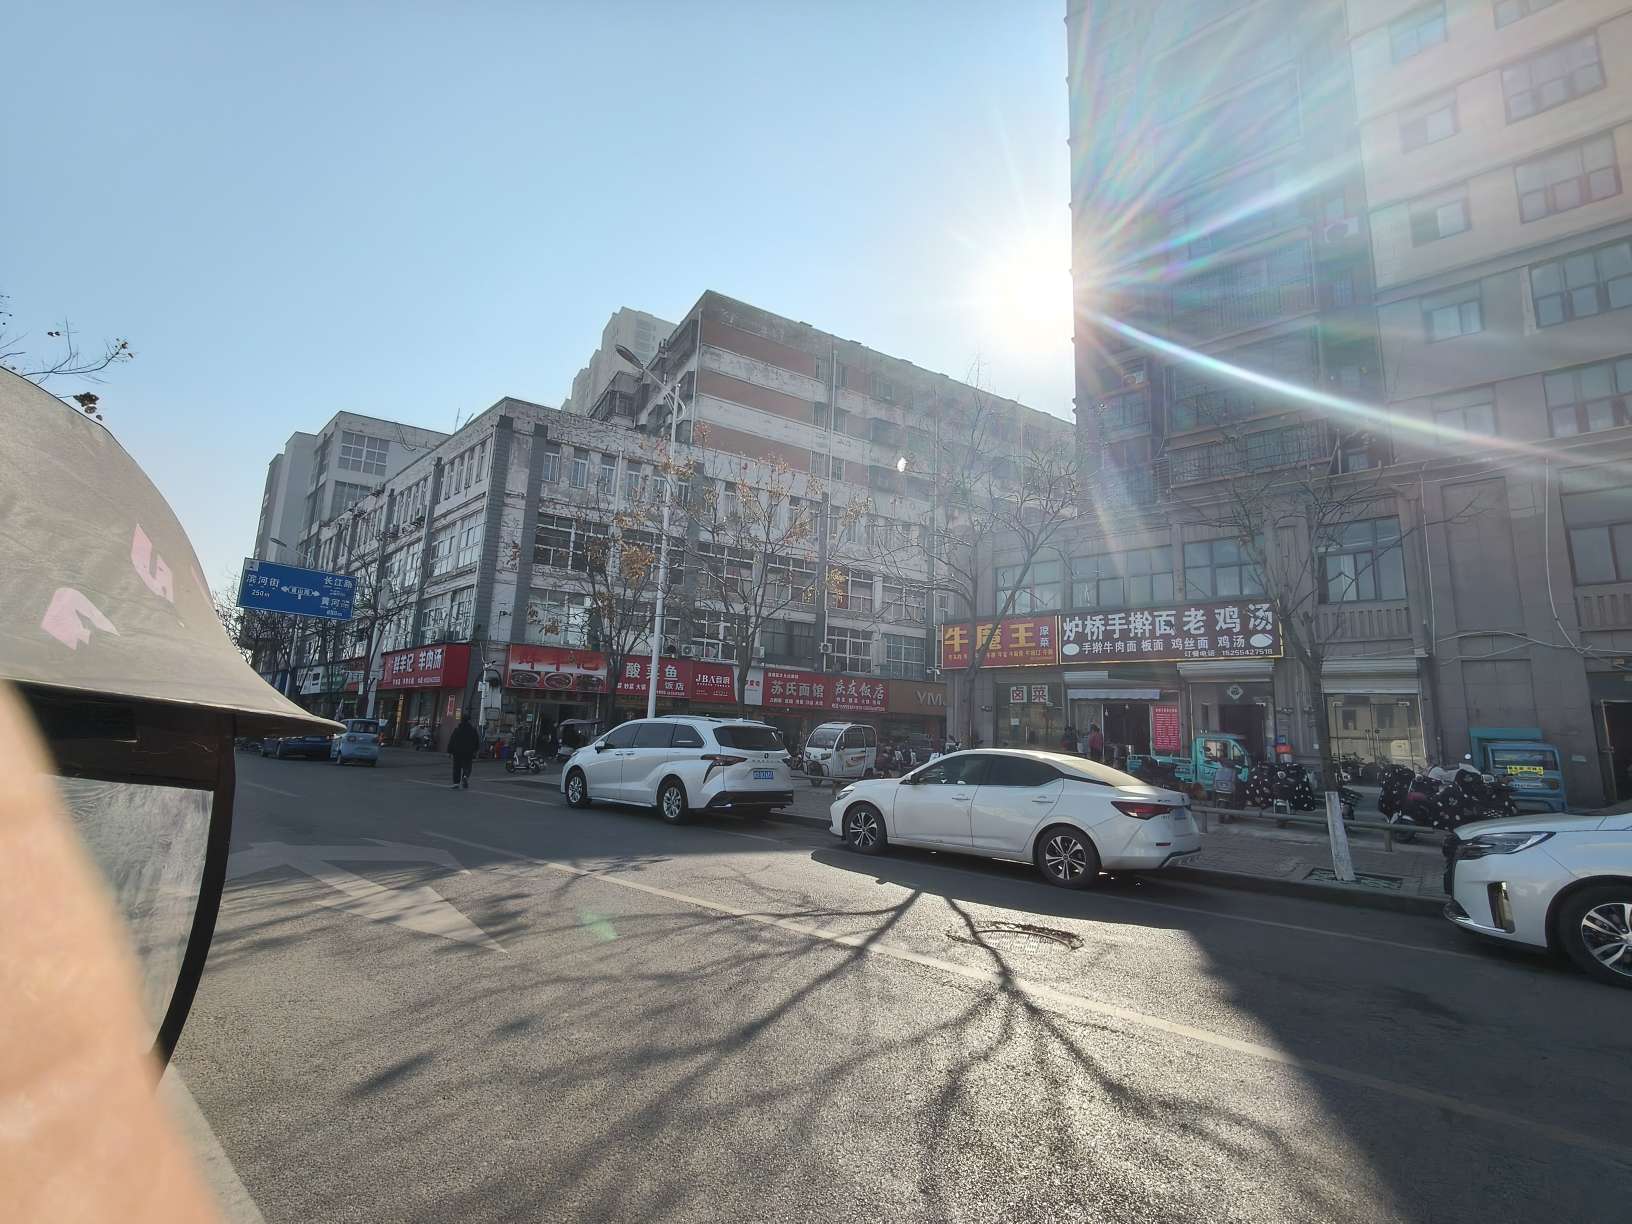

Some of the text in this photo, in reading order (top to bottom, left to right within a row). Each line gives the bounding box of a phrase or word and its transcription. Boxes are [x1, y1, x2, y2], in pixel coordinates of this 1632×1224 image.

[246, 574, 280, 588] 滨河街
[324, 576, 353, 590] 长江路
[1082, 635, 1244, 654] 手擀牛肉面 板面 鸡丝面 鸡汤
[664, 681, 685, 691] 饭店
[769, 680, 825, 698] 苏氏面馆
[1012, 686, 1047, 704] 卤菜
